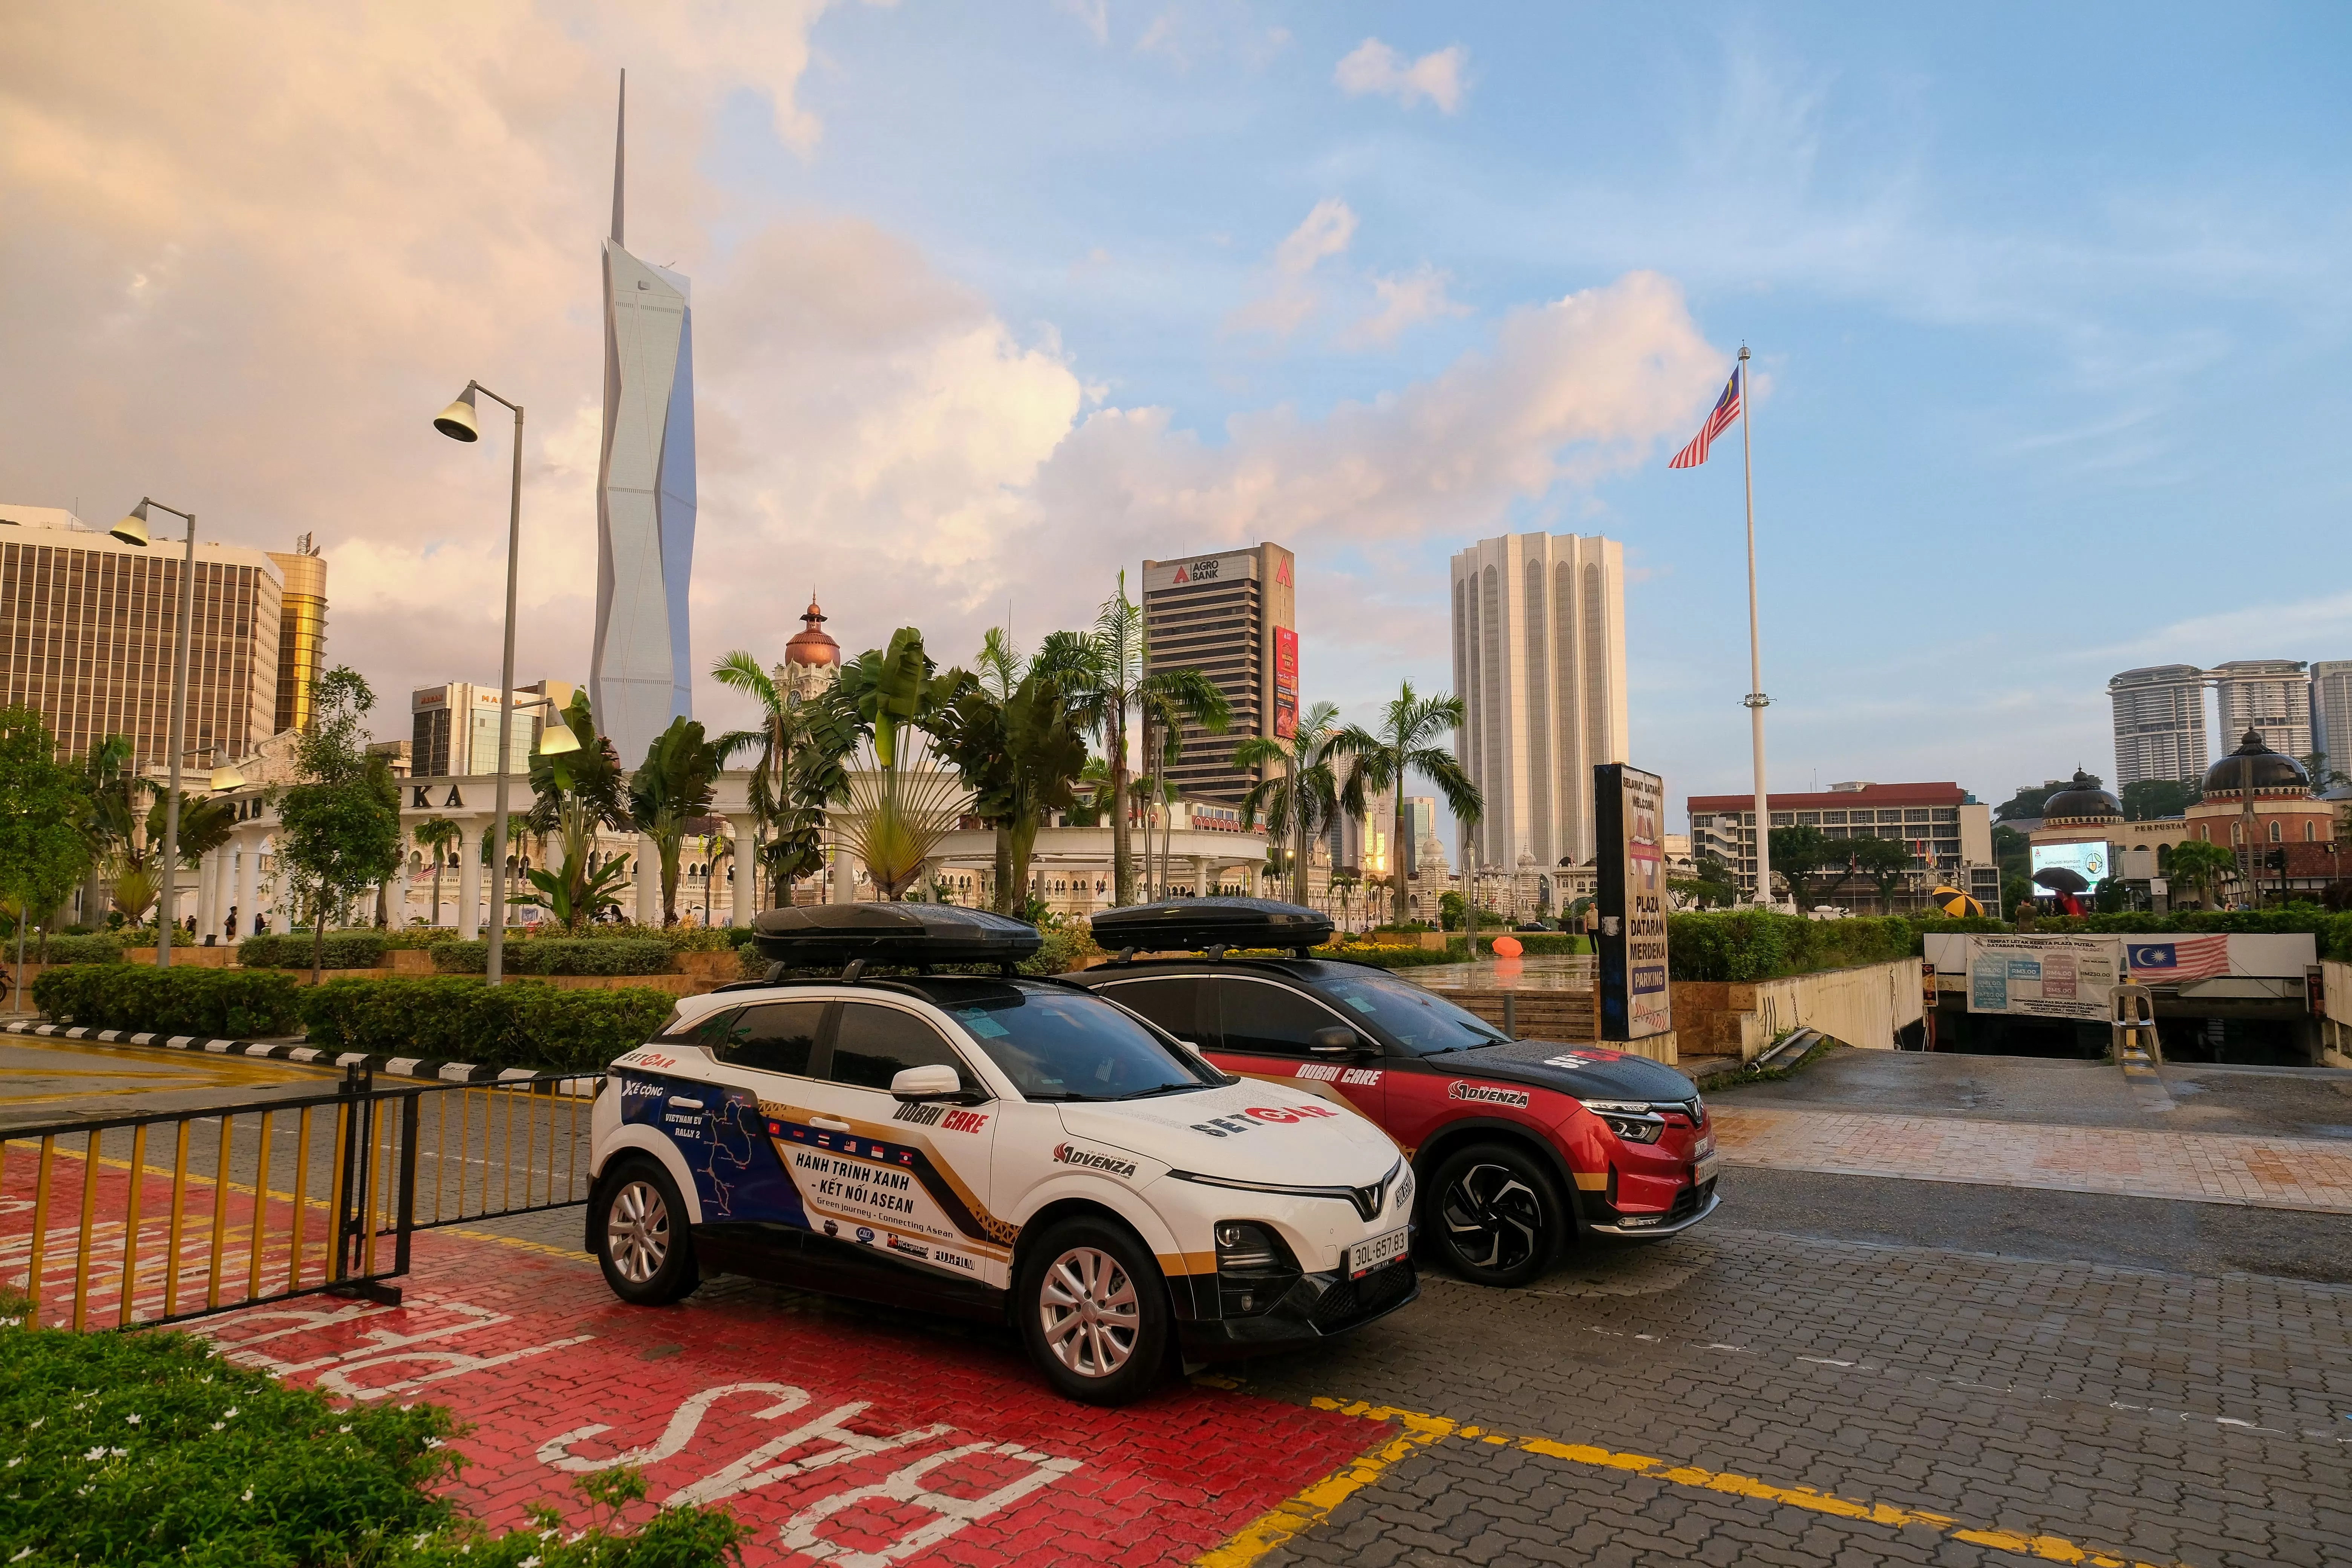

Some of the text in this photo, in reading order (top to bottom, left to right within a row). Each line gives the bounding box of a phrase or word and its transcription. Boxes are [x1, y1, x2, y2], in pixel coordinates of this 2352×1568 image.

[1193, 560, 1219, 572] AGRO
[1193, 569, 1218, 581] BANK
[482, 695, 522, 705] MAN
[1623, 776, 1661, 797] SELAMAT DATANG
[1632, 796, 1654, 811] WELCOME
[1636, 896, 1659, 913] PLAZA
[1631, 919, 1664, 936] DATARAN
[1630, 943, 1665, 960] MERDEKA
[1635, 971, 1663, 988] PARKING
[1295, 1064, 1383, 1086] DUBAI CARE
[622, 1080, 663, 1098] XẾ CỘNG
[1449, 1081, 1528, 1106] ADVENZA
[665, 1113, 702, 1125] VIETNAM EV
[892, 1102, 989, 1134] DUBAI CARE
[1190, 1106, 1340, 1137] SETCAR
[675, 1128, 695, 1138] RALLY
[1053, 1142, 1136, 1177] ADVENZA
[796, 1152, 910, 1191] HÀNH TRÌNH XANH
[819, 1177, 843, 1197] KẾT
[845, 1183, 868, 1203] NỐI
[870, 1191, 914, 1214] ASEAN
[817, 1197, 839, 1209] Green
[879, 1213, 924, 1232] Connecting
[926, 1225, 953, 1239] Asean
[1355, 1232, 1404, 1267] 30L-657.83
[934, 1250, 975, 1270] FUJIFILM
